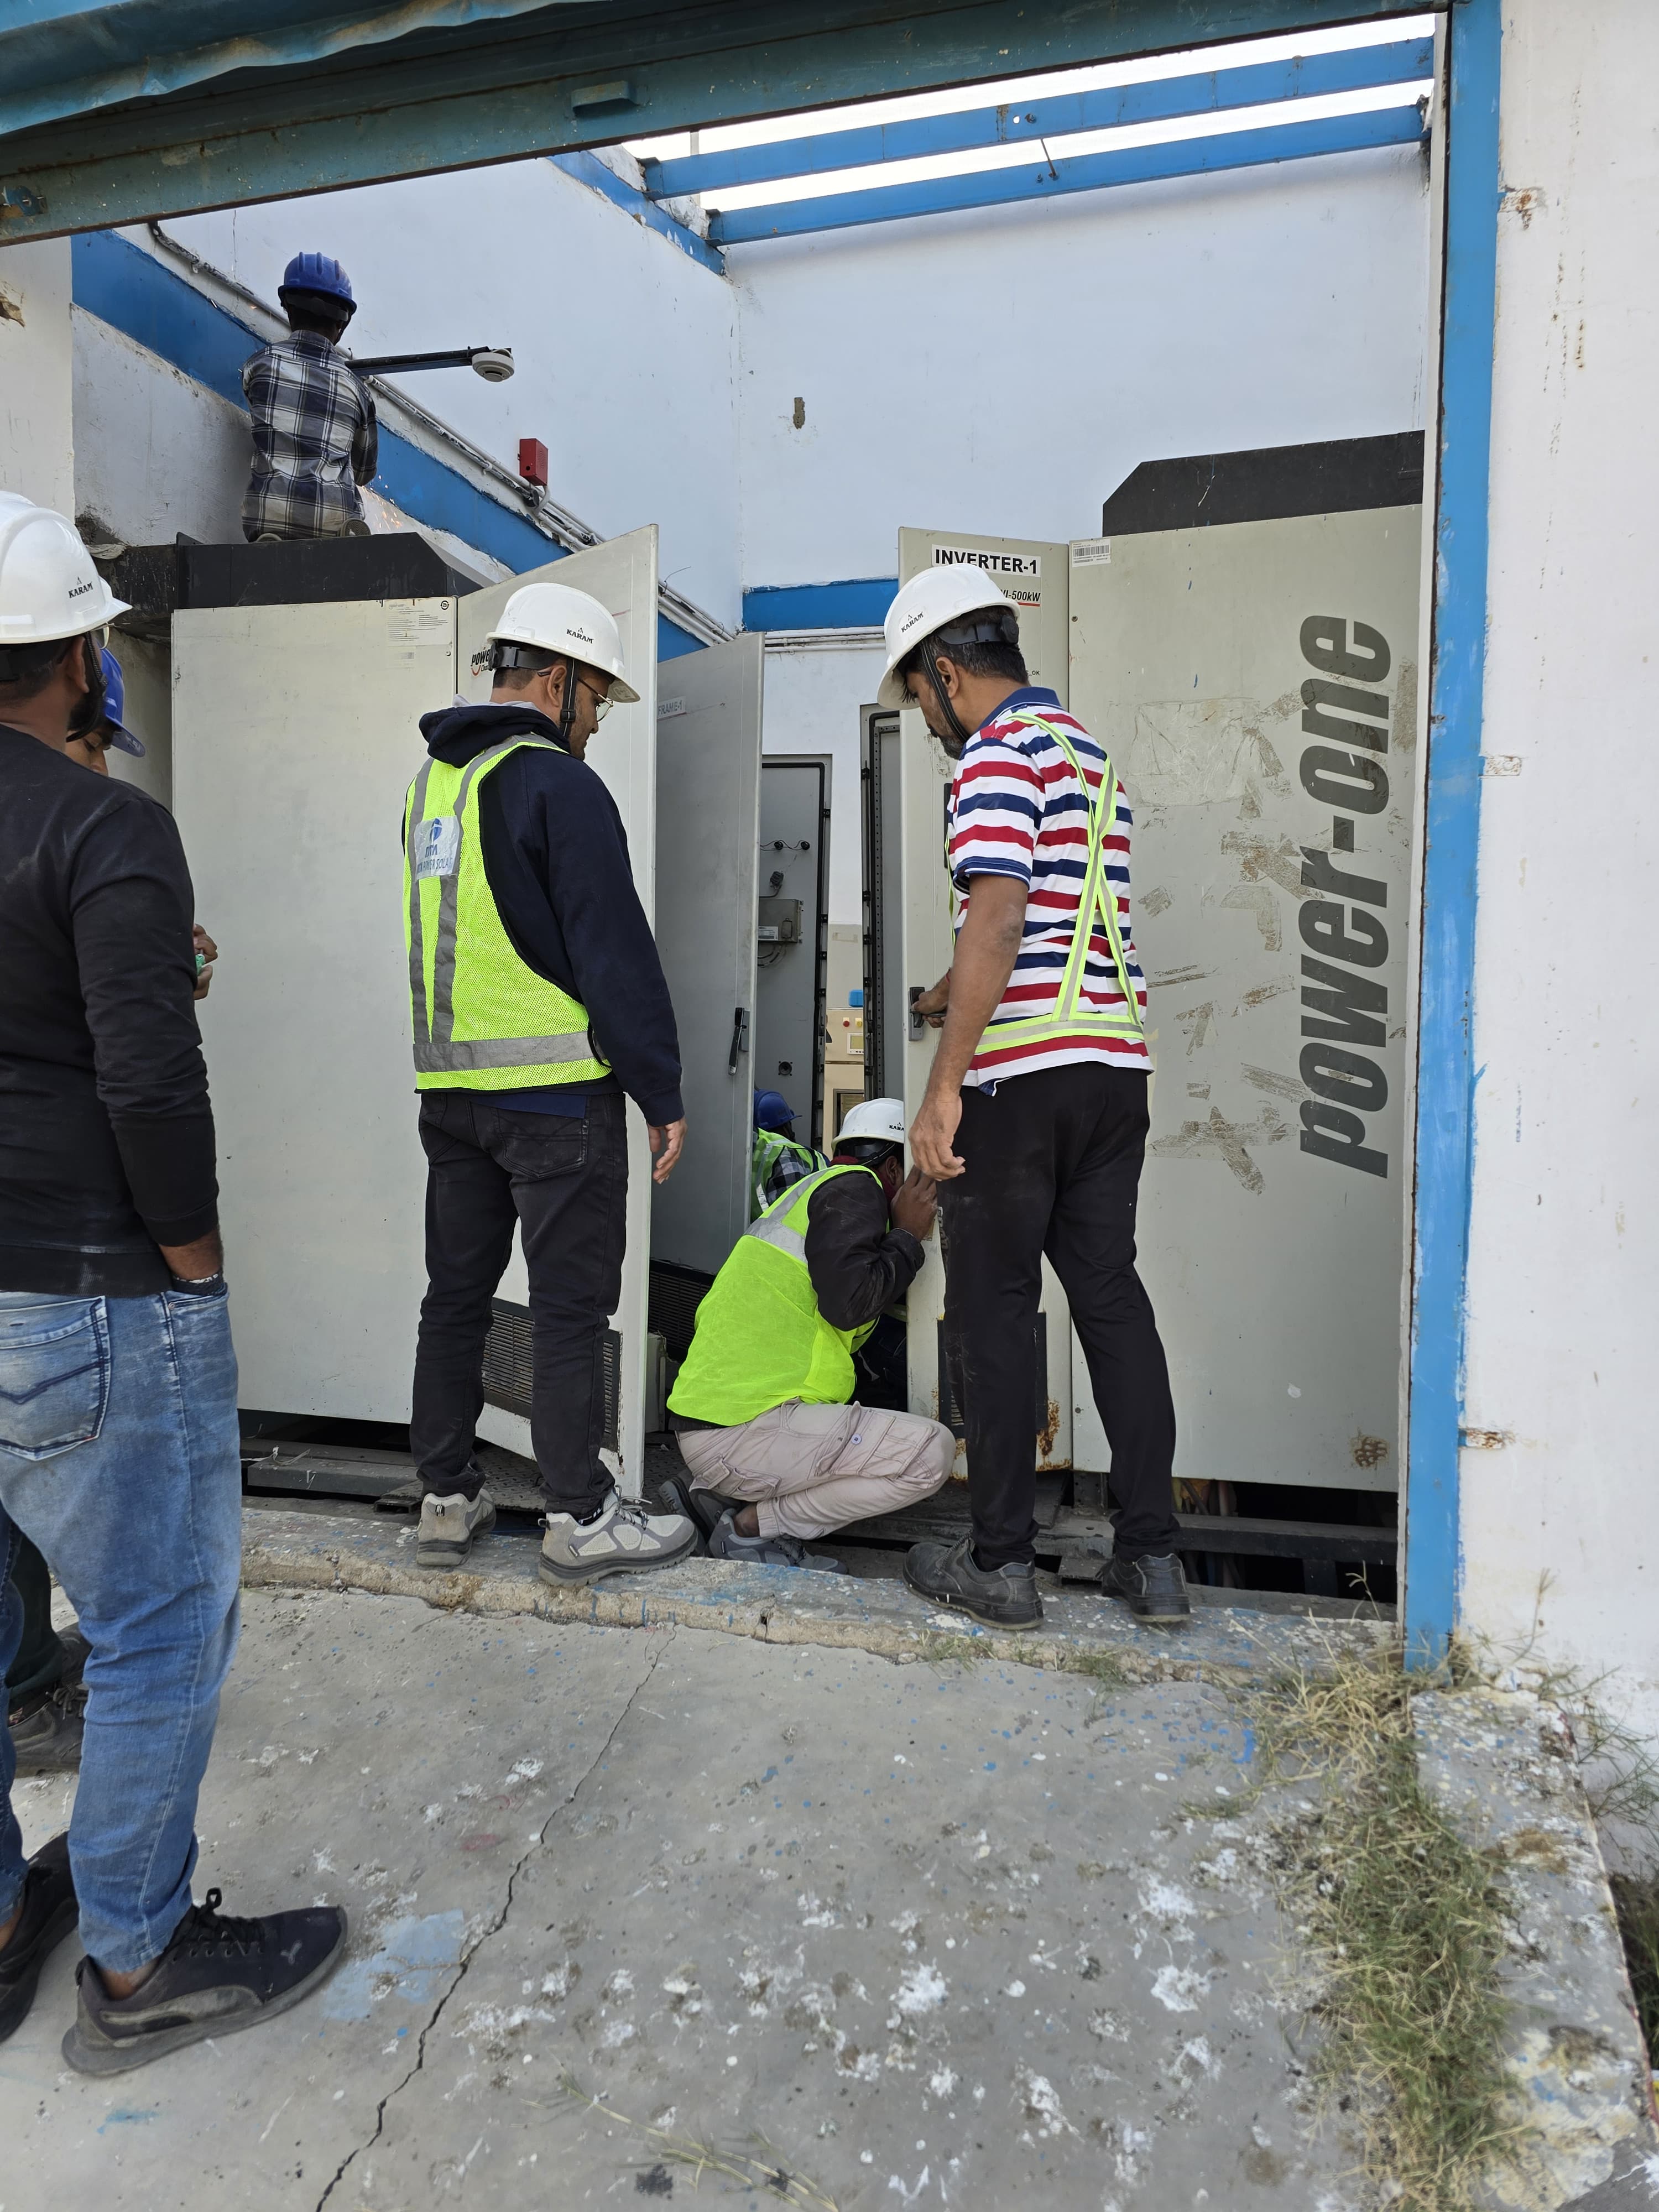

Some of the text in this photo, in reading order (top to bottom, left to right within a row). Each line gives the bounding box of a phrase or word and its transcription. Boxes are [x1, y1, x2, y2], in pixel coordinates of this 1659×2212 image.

[935, 549, 1037, 575] INVERTER-1
[68, 582, 93, 598] KARAM
[1000, 589, 1041, 602] VI-500kW
[901, 611, 924, 633] KARAM
[566, 629, 593, 644] KARAM
[471, 649, 491, 667] powe
[1298, 614, 1391, 1178] power-one
